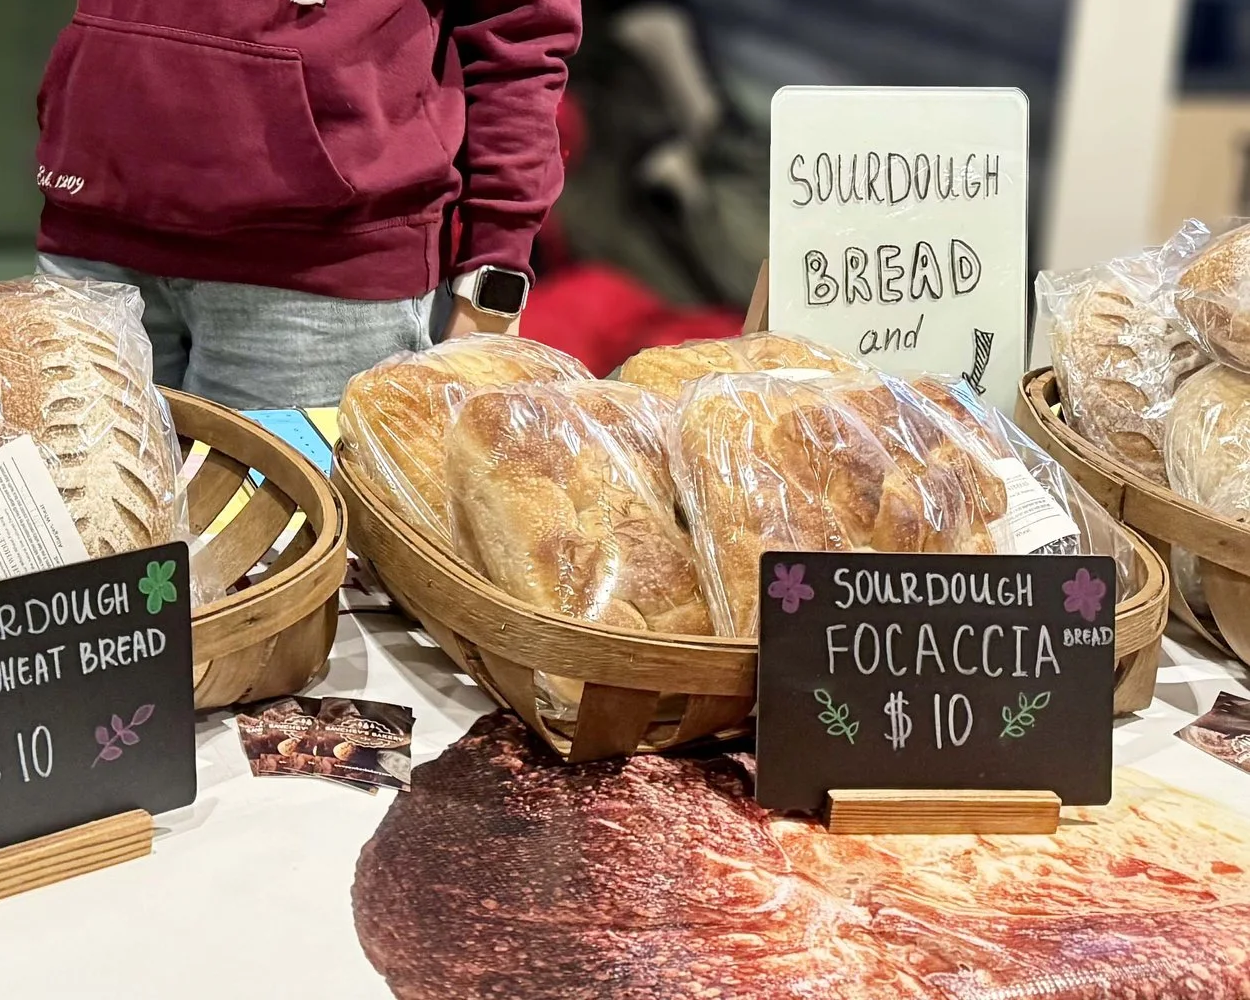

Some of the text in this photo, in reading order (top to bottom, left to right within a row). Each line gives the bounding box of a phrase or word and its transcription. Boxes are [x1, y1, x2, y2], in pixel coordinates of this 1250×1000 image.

[54, 174, 85, 195] 1209
[790, 151, 1000, 206] SOURDOUGH
[804, 238, 981, 306] BREAD
[858, 313, 925, 356] and
[0, 538, 15, 565] WHOLE
[833, 568, 1034, 609] SOURDOUGH
[78, 627, 167, 676] BREAD
[825, 622, 1114, 678] FOCACCIA BREAD
[883, 690, 974, 751] $ 10
[17, 724, 54, 783] 10
